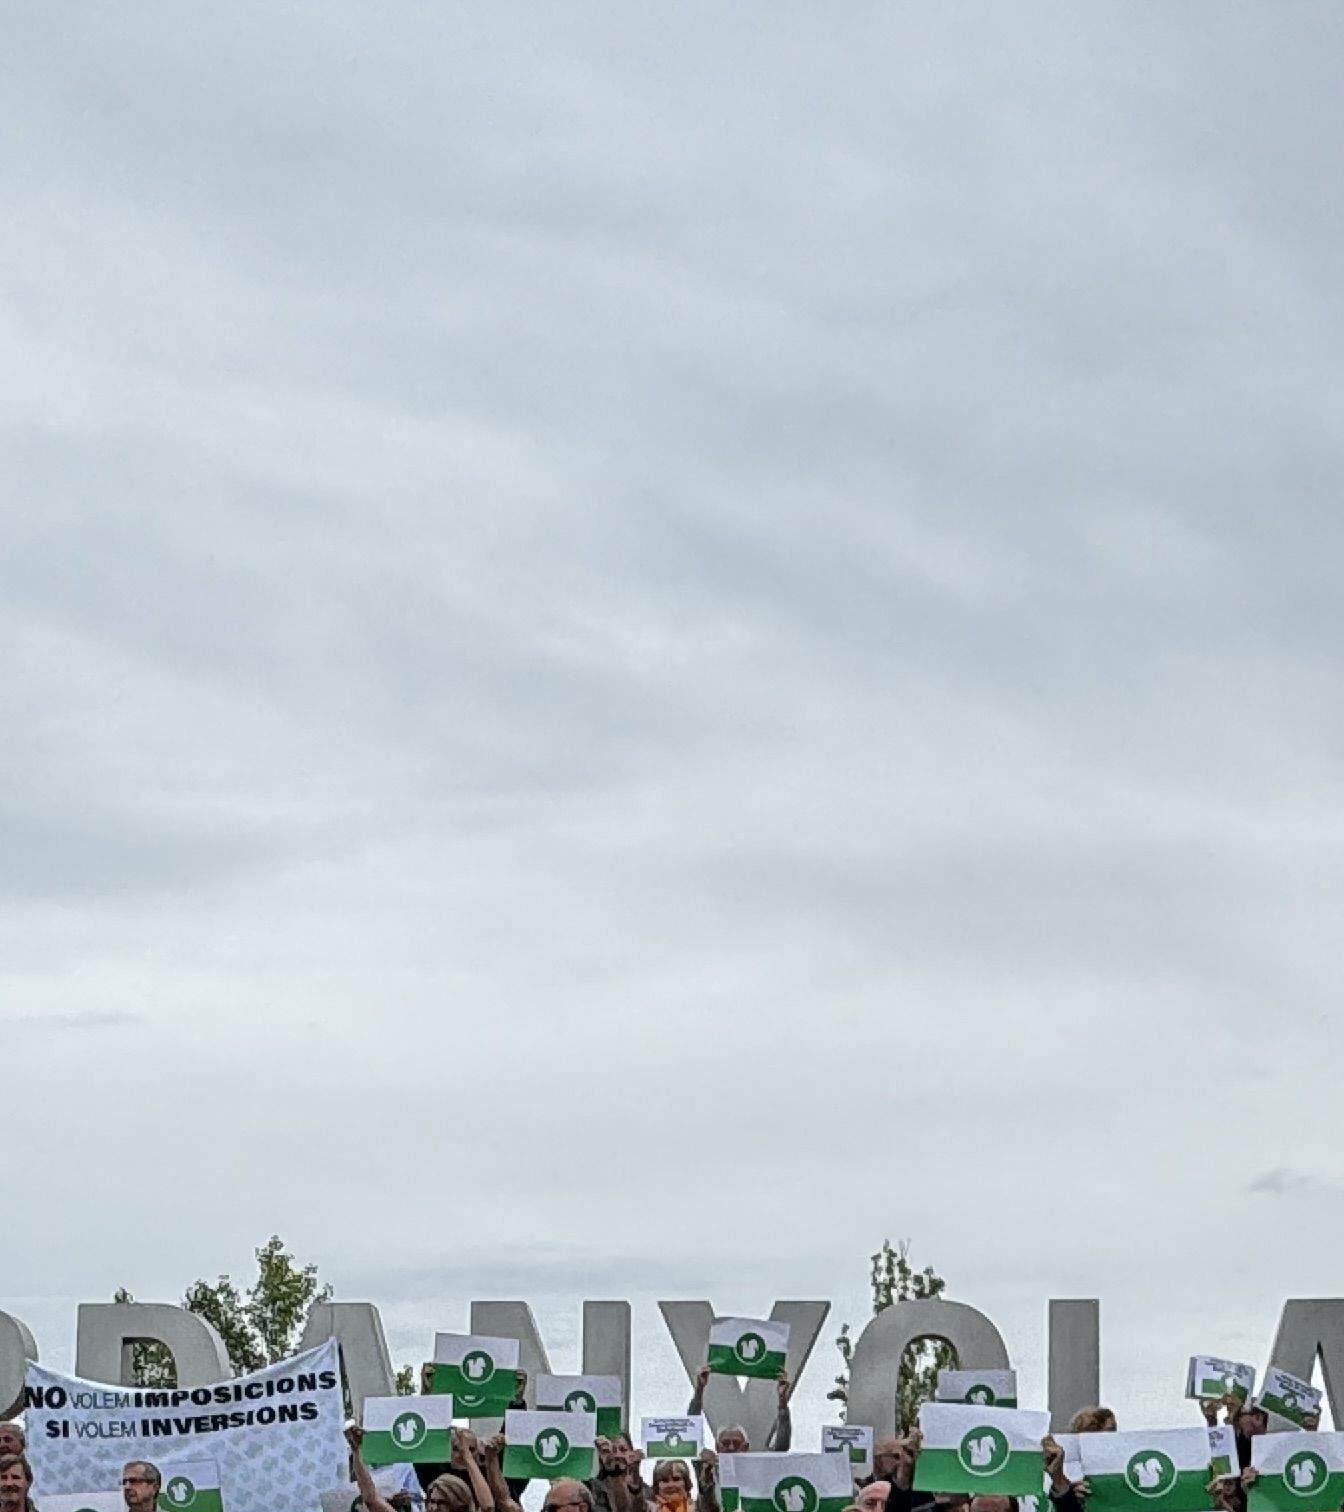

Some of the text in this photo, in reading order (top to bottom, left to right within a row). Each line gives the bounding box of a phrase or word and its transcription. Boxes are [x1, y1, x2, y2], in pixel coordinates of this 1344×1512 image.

[23, 1370, 337, 1409] NO VOLEM IMPOSICIONS
[45, 1401, 319, 1438] SI VOLEM INVERSIONS
